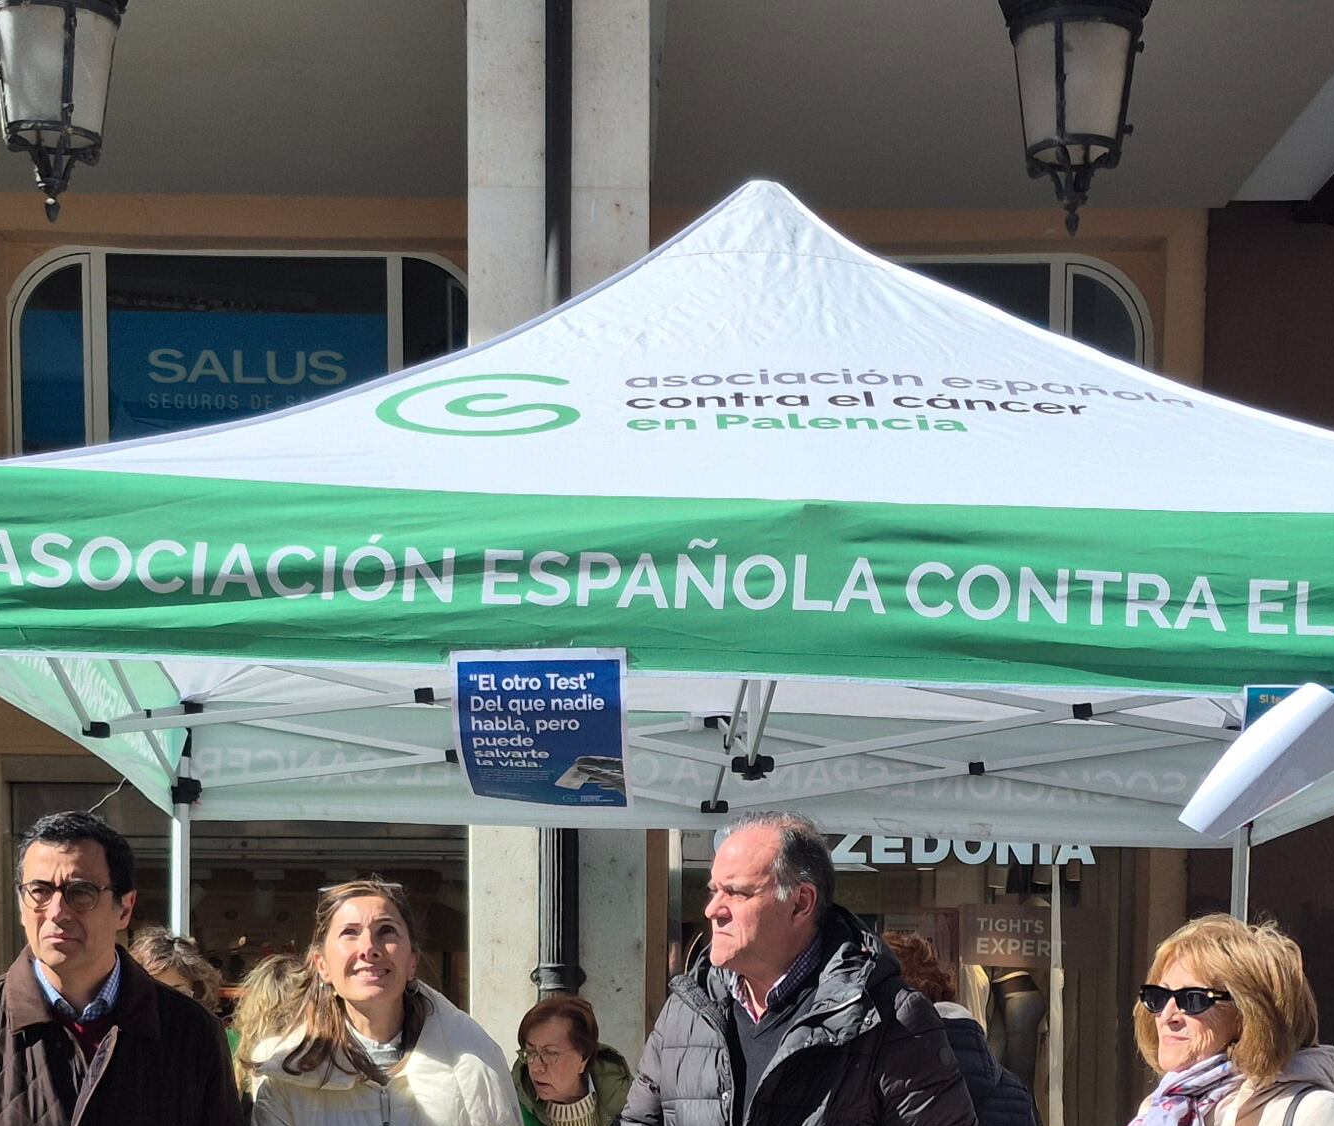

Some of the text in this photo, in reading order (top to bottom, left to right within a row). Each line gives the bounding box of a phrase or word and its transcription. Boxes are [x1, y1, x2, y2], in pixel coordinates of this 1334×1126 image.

[147, 348, 347, 385] SALUS
[625, 368, 1195, 408] asociación española
[148, 393, 239, 410] SEGUROS
[625, 391, 1087, 415] contra el cáncer
[626, 413, 968, 432] en Palencia
[480, 537, 887, 615] ESPAÑOLA
[905, 561, 1227, 632] CONTRA
[501, 675, 542, 691] otro
[470, 694, 605, 715] Del que nadie
[470, 716, 580, 734] habla, pero
[472, 735, 534, 749] puede
[474, 748, 550, 759] salvarte
[476, 758, 543, 768] la vida.
[976, 917, 1045, 934] TIGHTS
